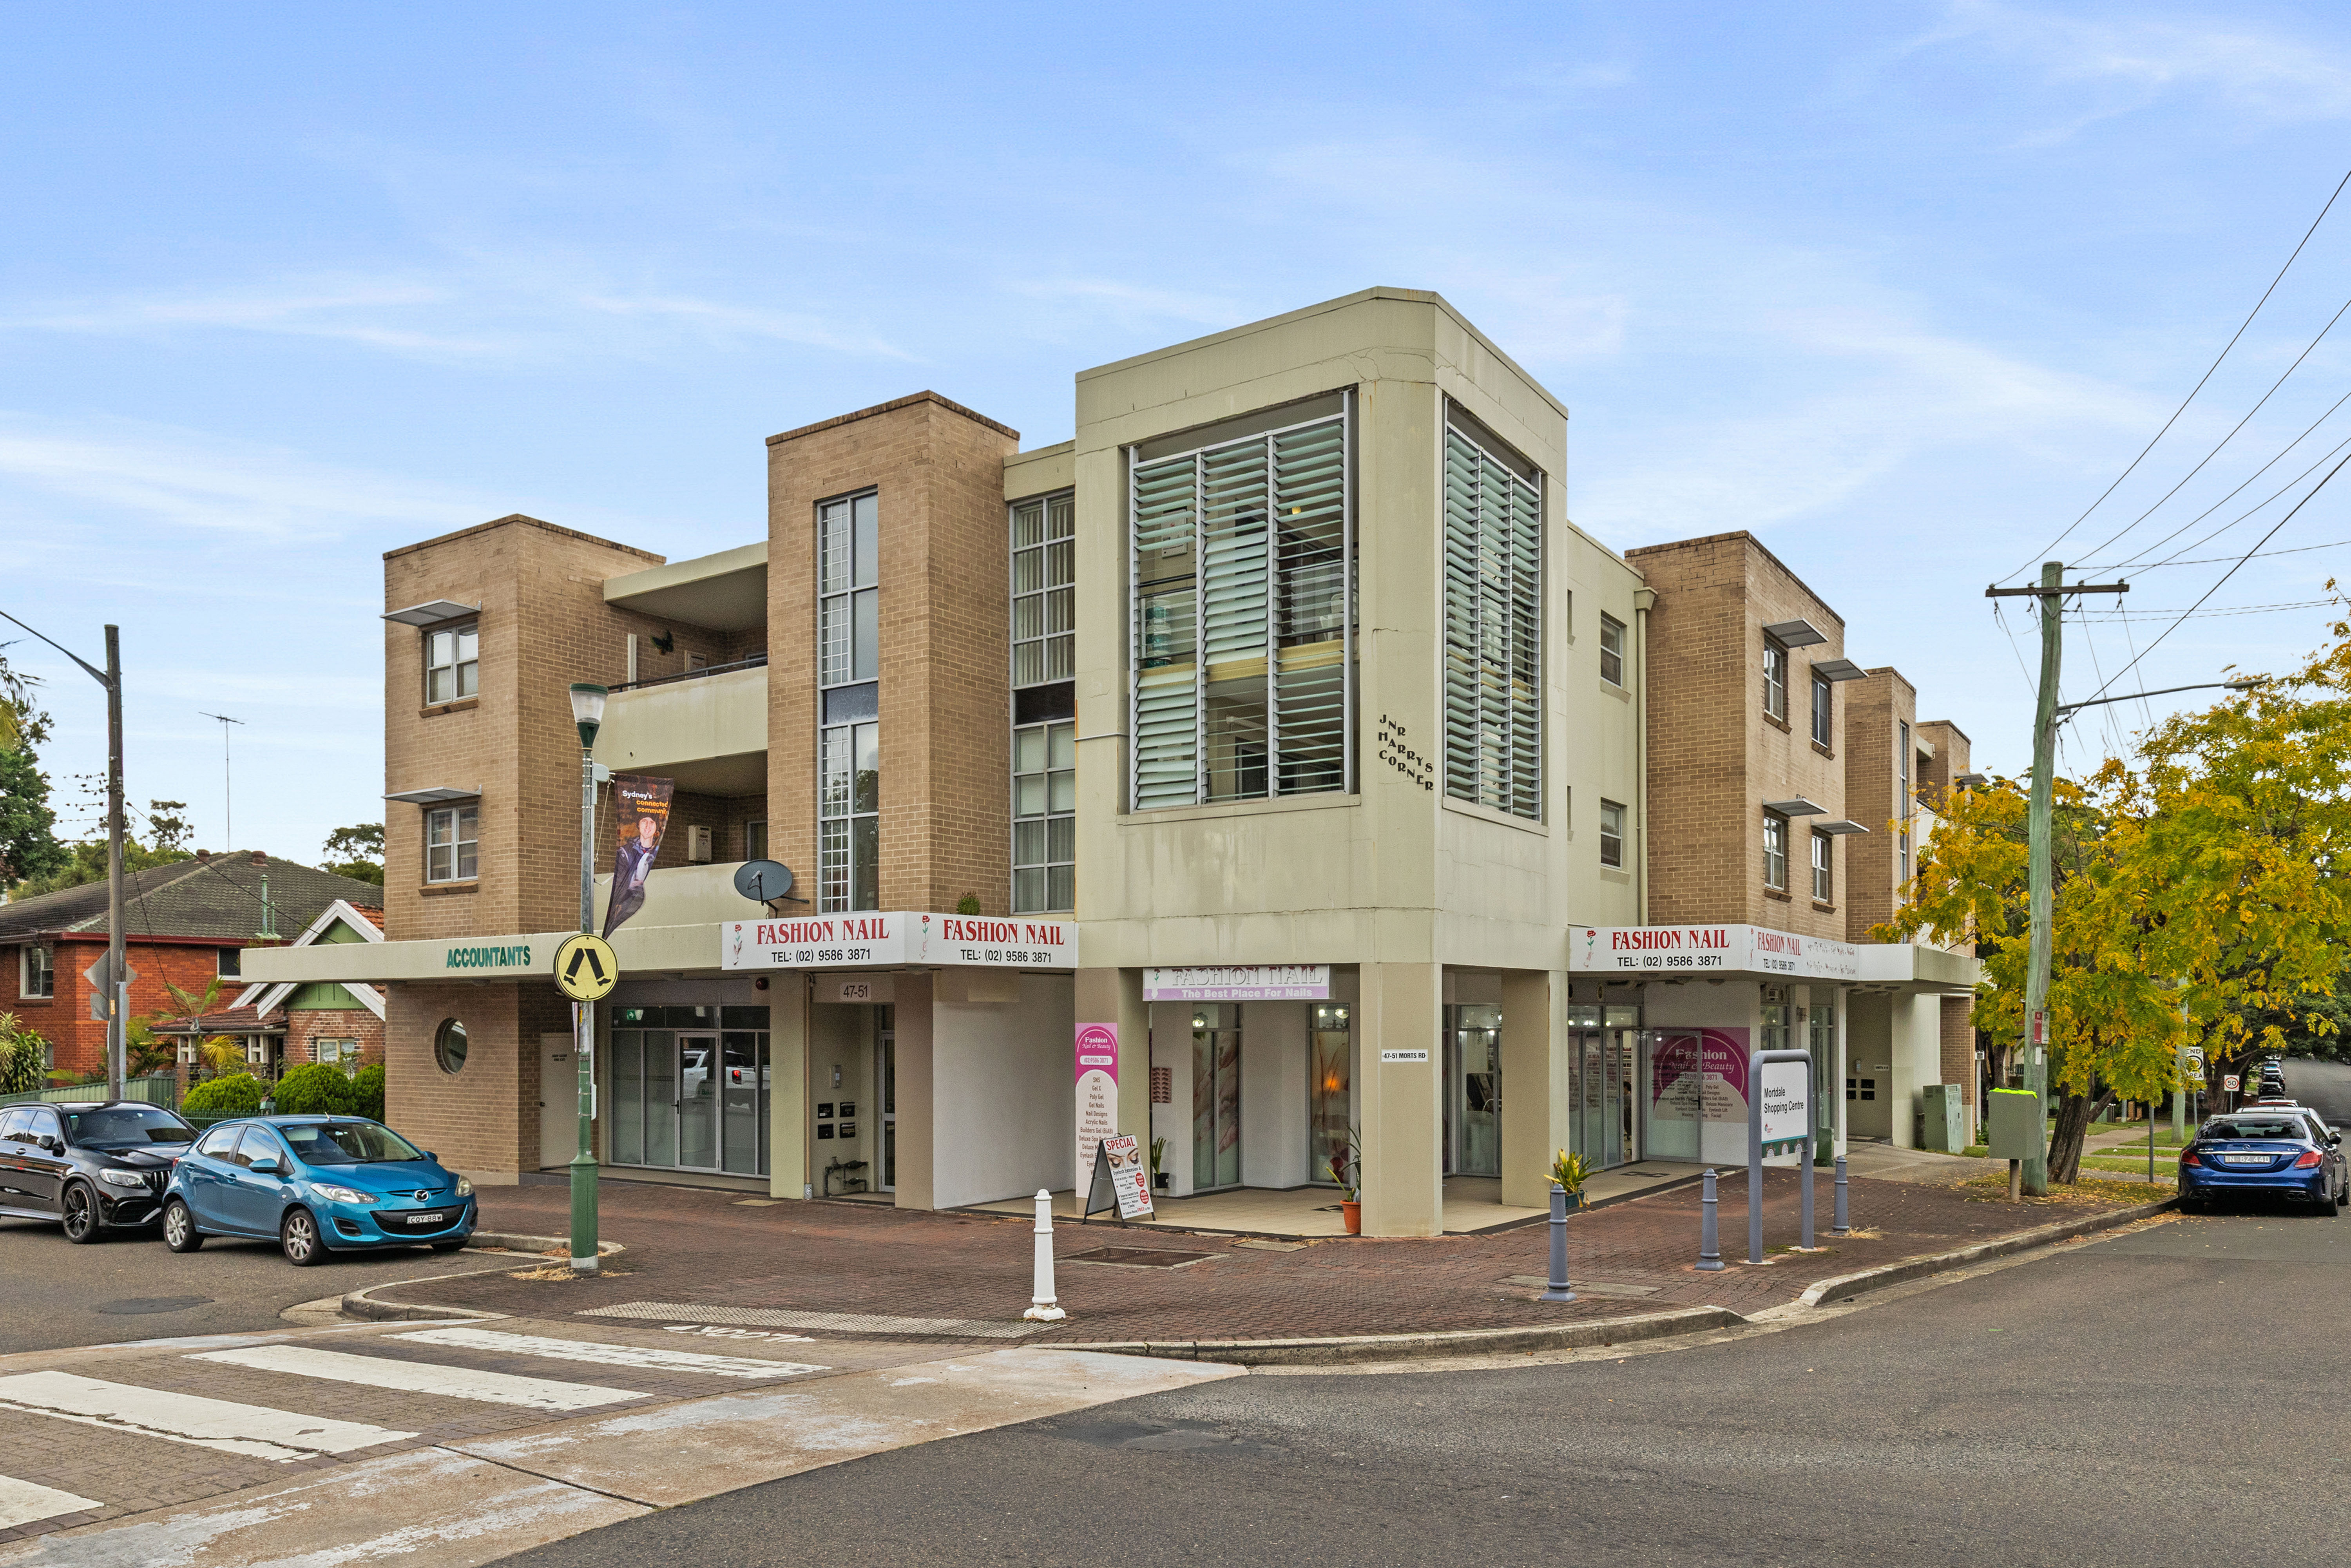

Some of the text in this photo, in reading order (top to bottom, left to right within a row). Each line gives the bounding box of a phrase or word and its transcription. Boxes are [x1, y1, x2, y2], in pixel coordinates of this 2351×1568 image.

[1380, 714, 1406, 736] JNR
[1378, 732, 1433, 772] HARRYS
[1379, 750, 1433, 791] CORNER
[622, 790, 652, 800] Sydney's
[757, 918, 890, 945] FASHION NAIL
[943, 919, 1065, 945] FASHION NAIL
[1612, 929, 1730, 950] FASHION NAIL
[1758, 931, 1785, 955] FASHION
[1787, 938, 1802, 956] NAIL
[446, 945, 531, 968] ACCOUNTANTS
[772, 949, 871, 963] TEL: (02) 9586 3871
[961, 949, 1052, 963] TEL: (02) 9586 3871
[1617, 955, 1722, 968] TEL: (02) 9586 3871
[1779, 960, 1787, 970] 9586
[843, 985, 869, 998] 47-51
[1182, 987, 1312, 998] The Best Place For Nails
[1703, 1061, 1735, 1074] Beauty
[1764, 1086, 1786, 1098] Mortdale
[1764, 1101, 1804, 1115] Shopping Centre
[1106, 1137, 1135, 1151] SPECIAL
